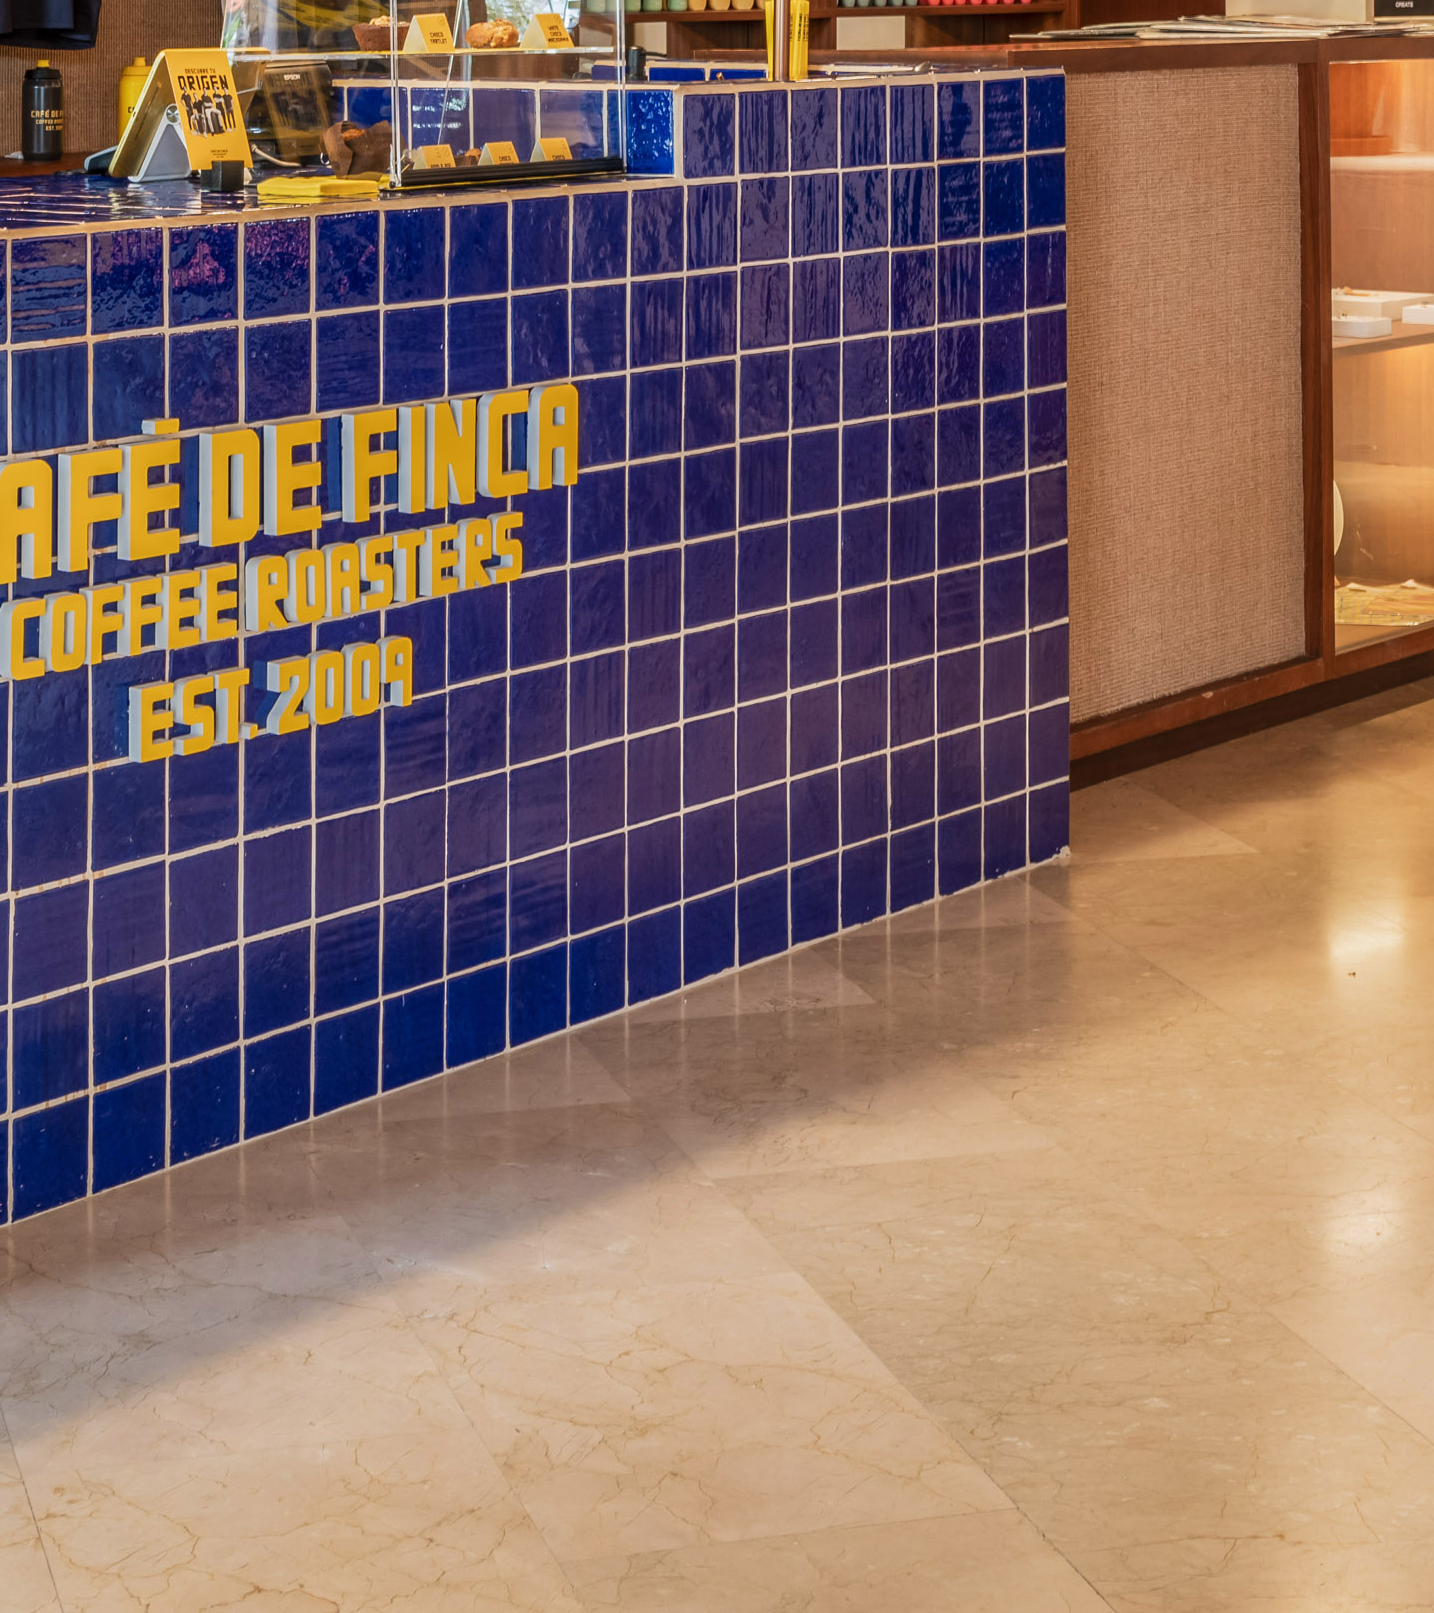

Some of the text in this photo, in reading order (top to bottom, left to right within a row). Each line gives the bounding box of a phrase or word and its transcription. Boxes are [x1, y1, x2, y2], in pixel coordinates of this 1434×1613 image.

[1395, 0, 1414, 9] CREATE
[30, 109, 50, 118] CAFÉ
[178, 75, 229, 91] ORIGEN
[198, 417, 323, 547] DE
[341, 384, 578, 522] FINCA
[245, 511, 523, 632] ROASTERS
[129, 636, 414, 763] EST. 2009
